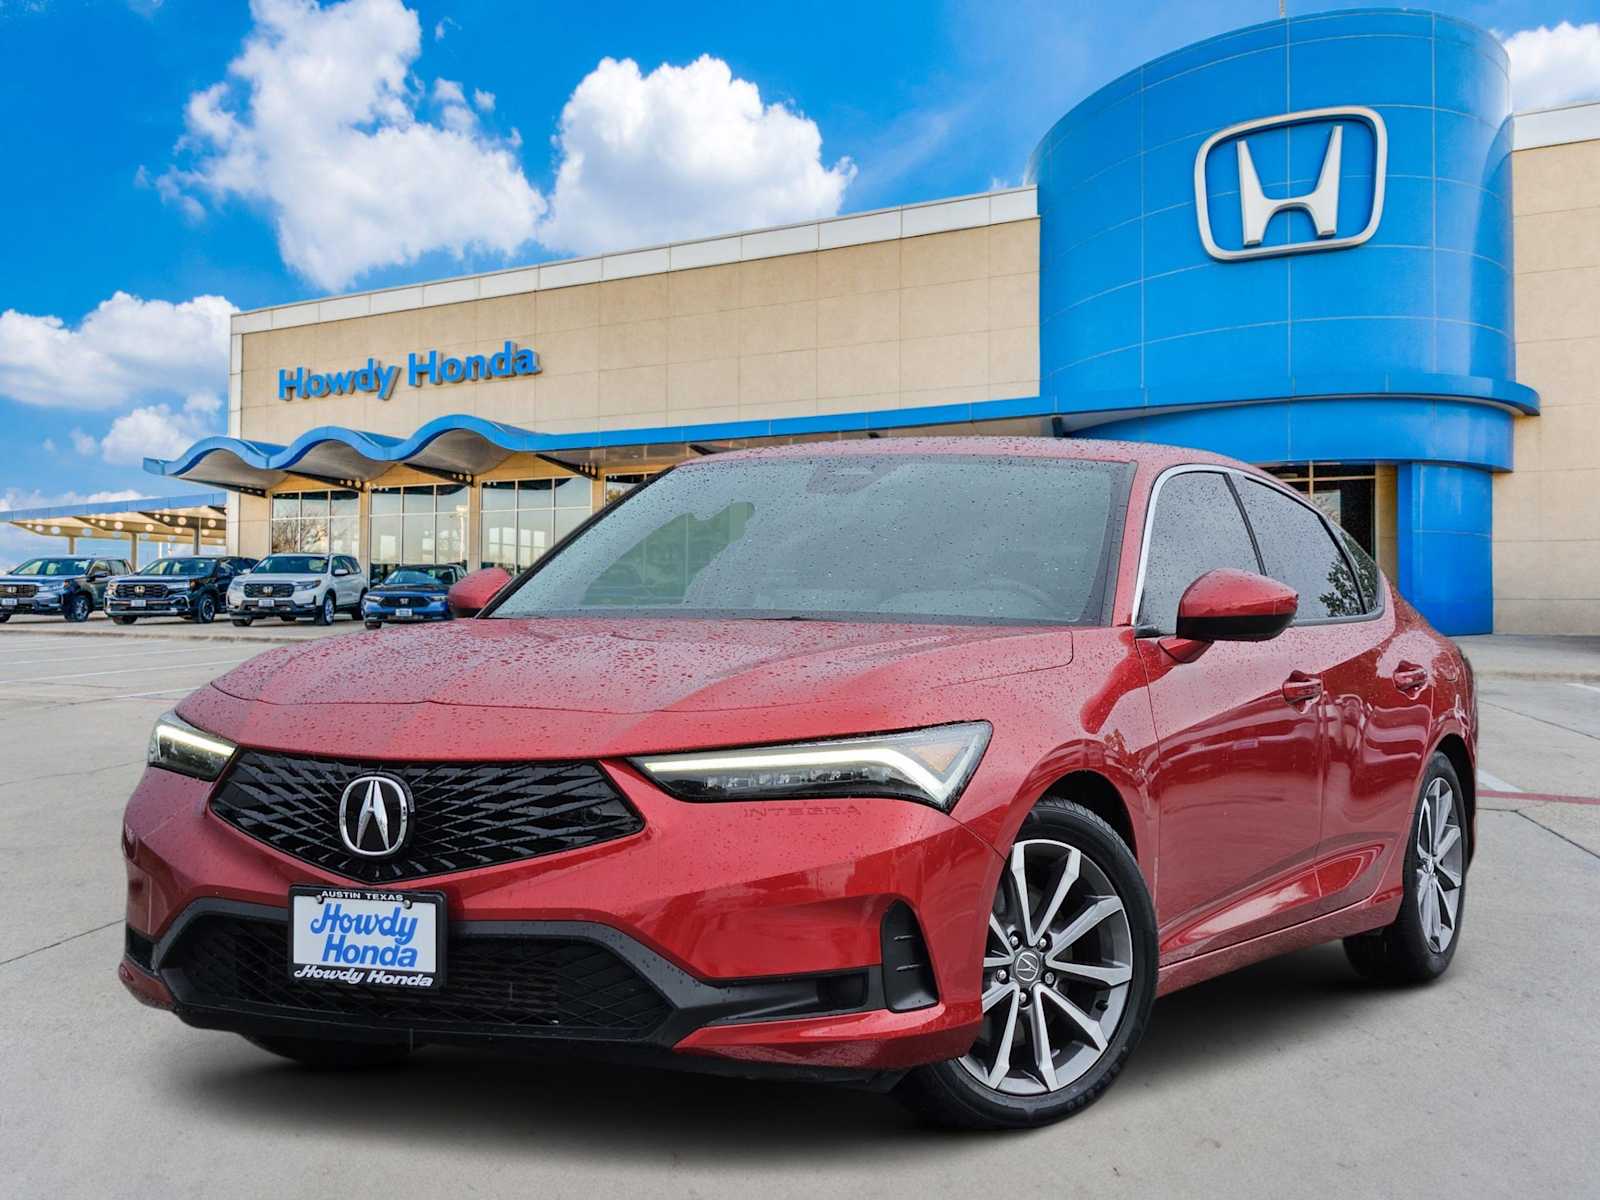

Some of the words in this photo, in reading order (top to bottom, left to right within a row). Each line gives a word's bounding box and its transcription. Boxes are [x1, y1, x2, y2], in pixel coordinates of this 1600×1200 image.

[278, 357, 400, 400] Howdy
[408, 340, 542, 387] Honda
[321, 890, 361, 899] AUSTIN
[365, 893, 404, 901] TEXAS
[310, 903, 419, 945] Howdy
[321, 934, 418, 967] Honda
[294, 965, 366, 985] Howdy
[367, 970, 434, 987] Honda
